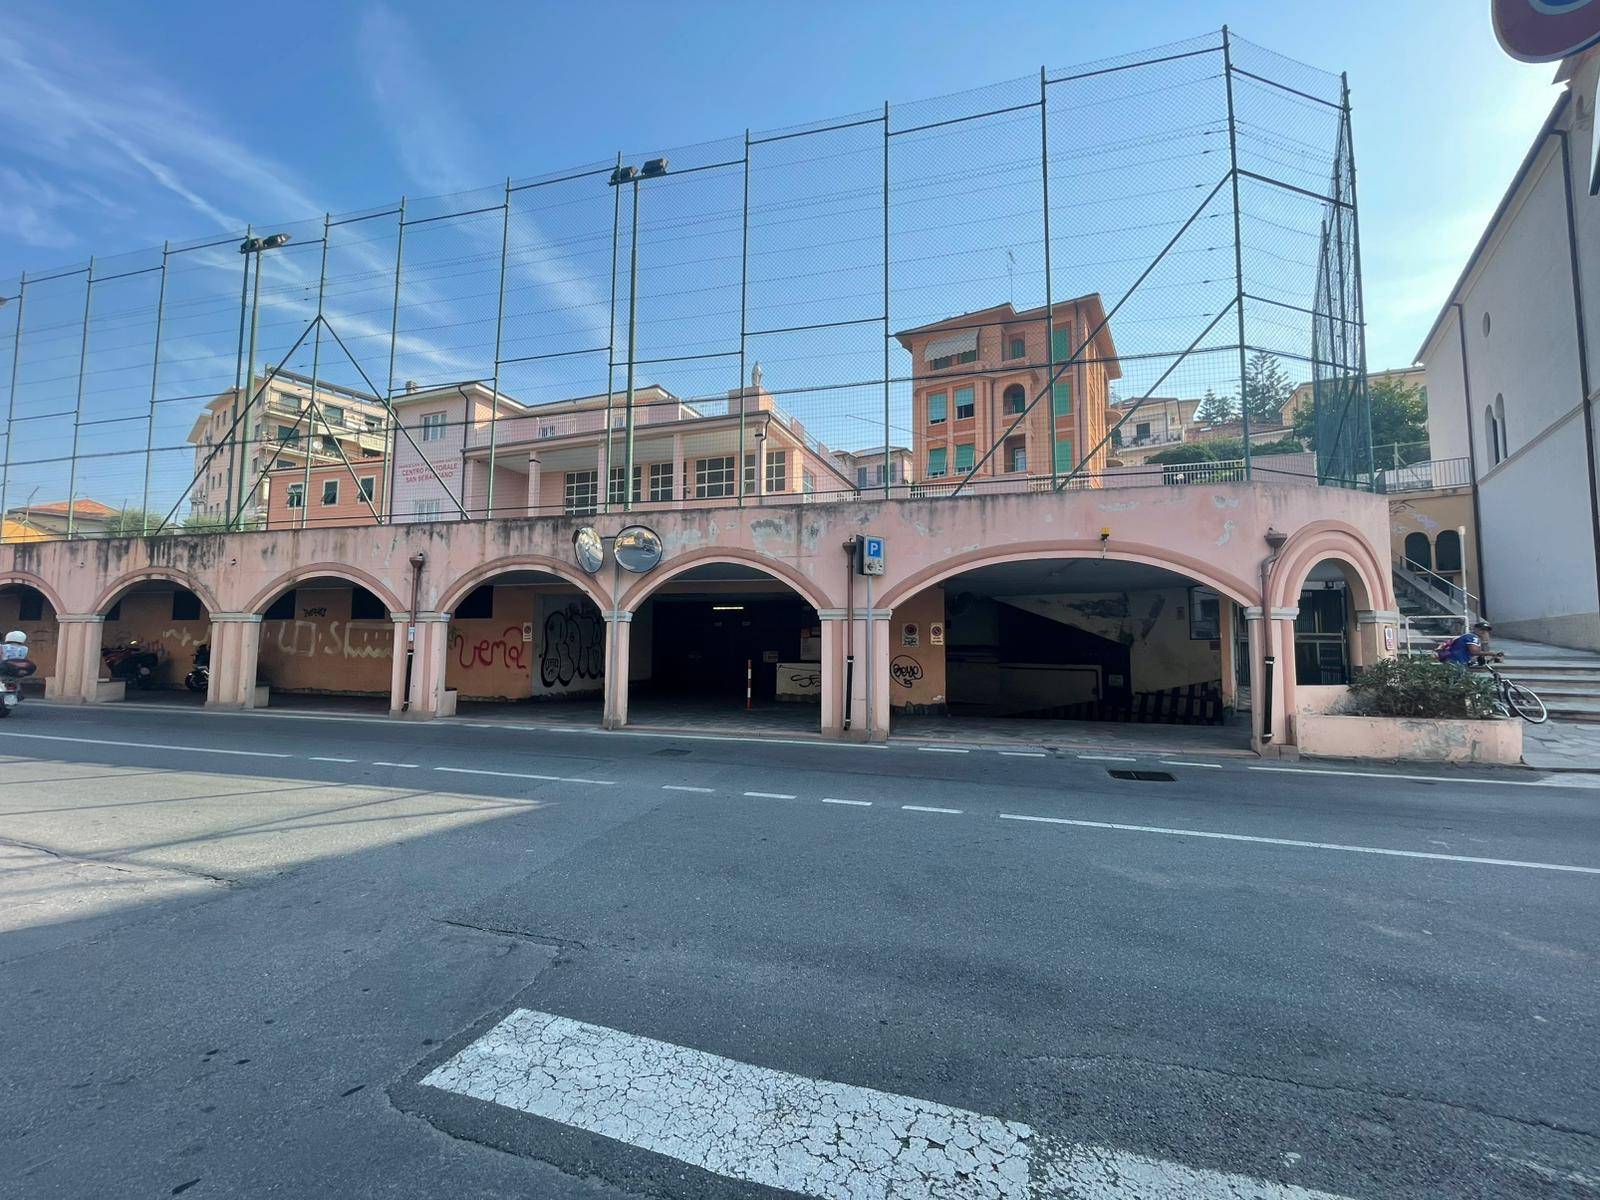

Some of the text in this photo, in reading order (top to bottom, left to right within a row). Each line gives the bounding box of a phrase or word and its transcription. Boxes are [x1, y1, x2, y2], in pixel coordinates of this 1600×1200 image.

[402, 467, 424, 476] CENTRO
[425, 463, 458, 472] PATORALE
[870, 542, 878, 555] P
